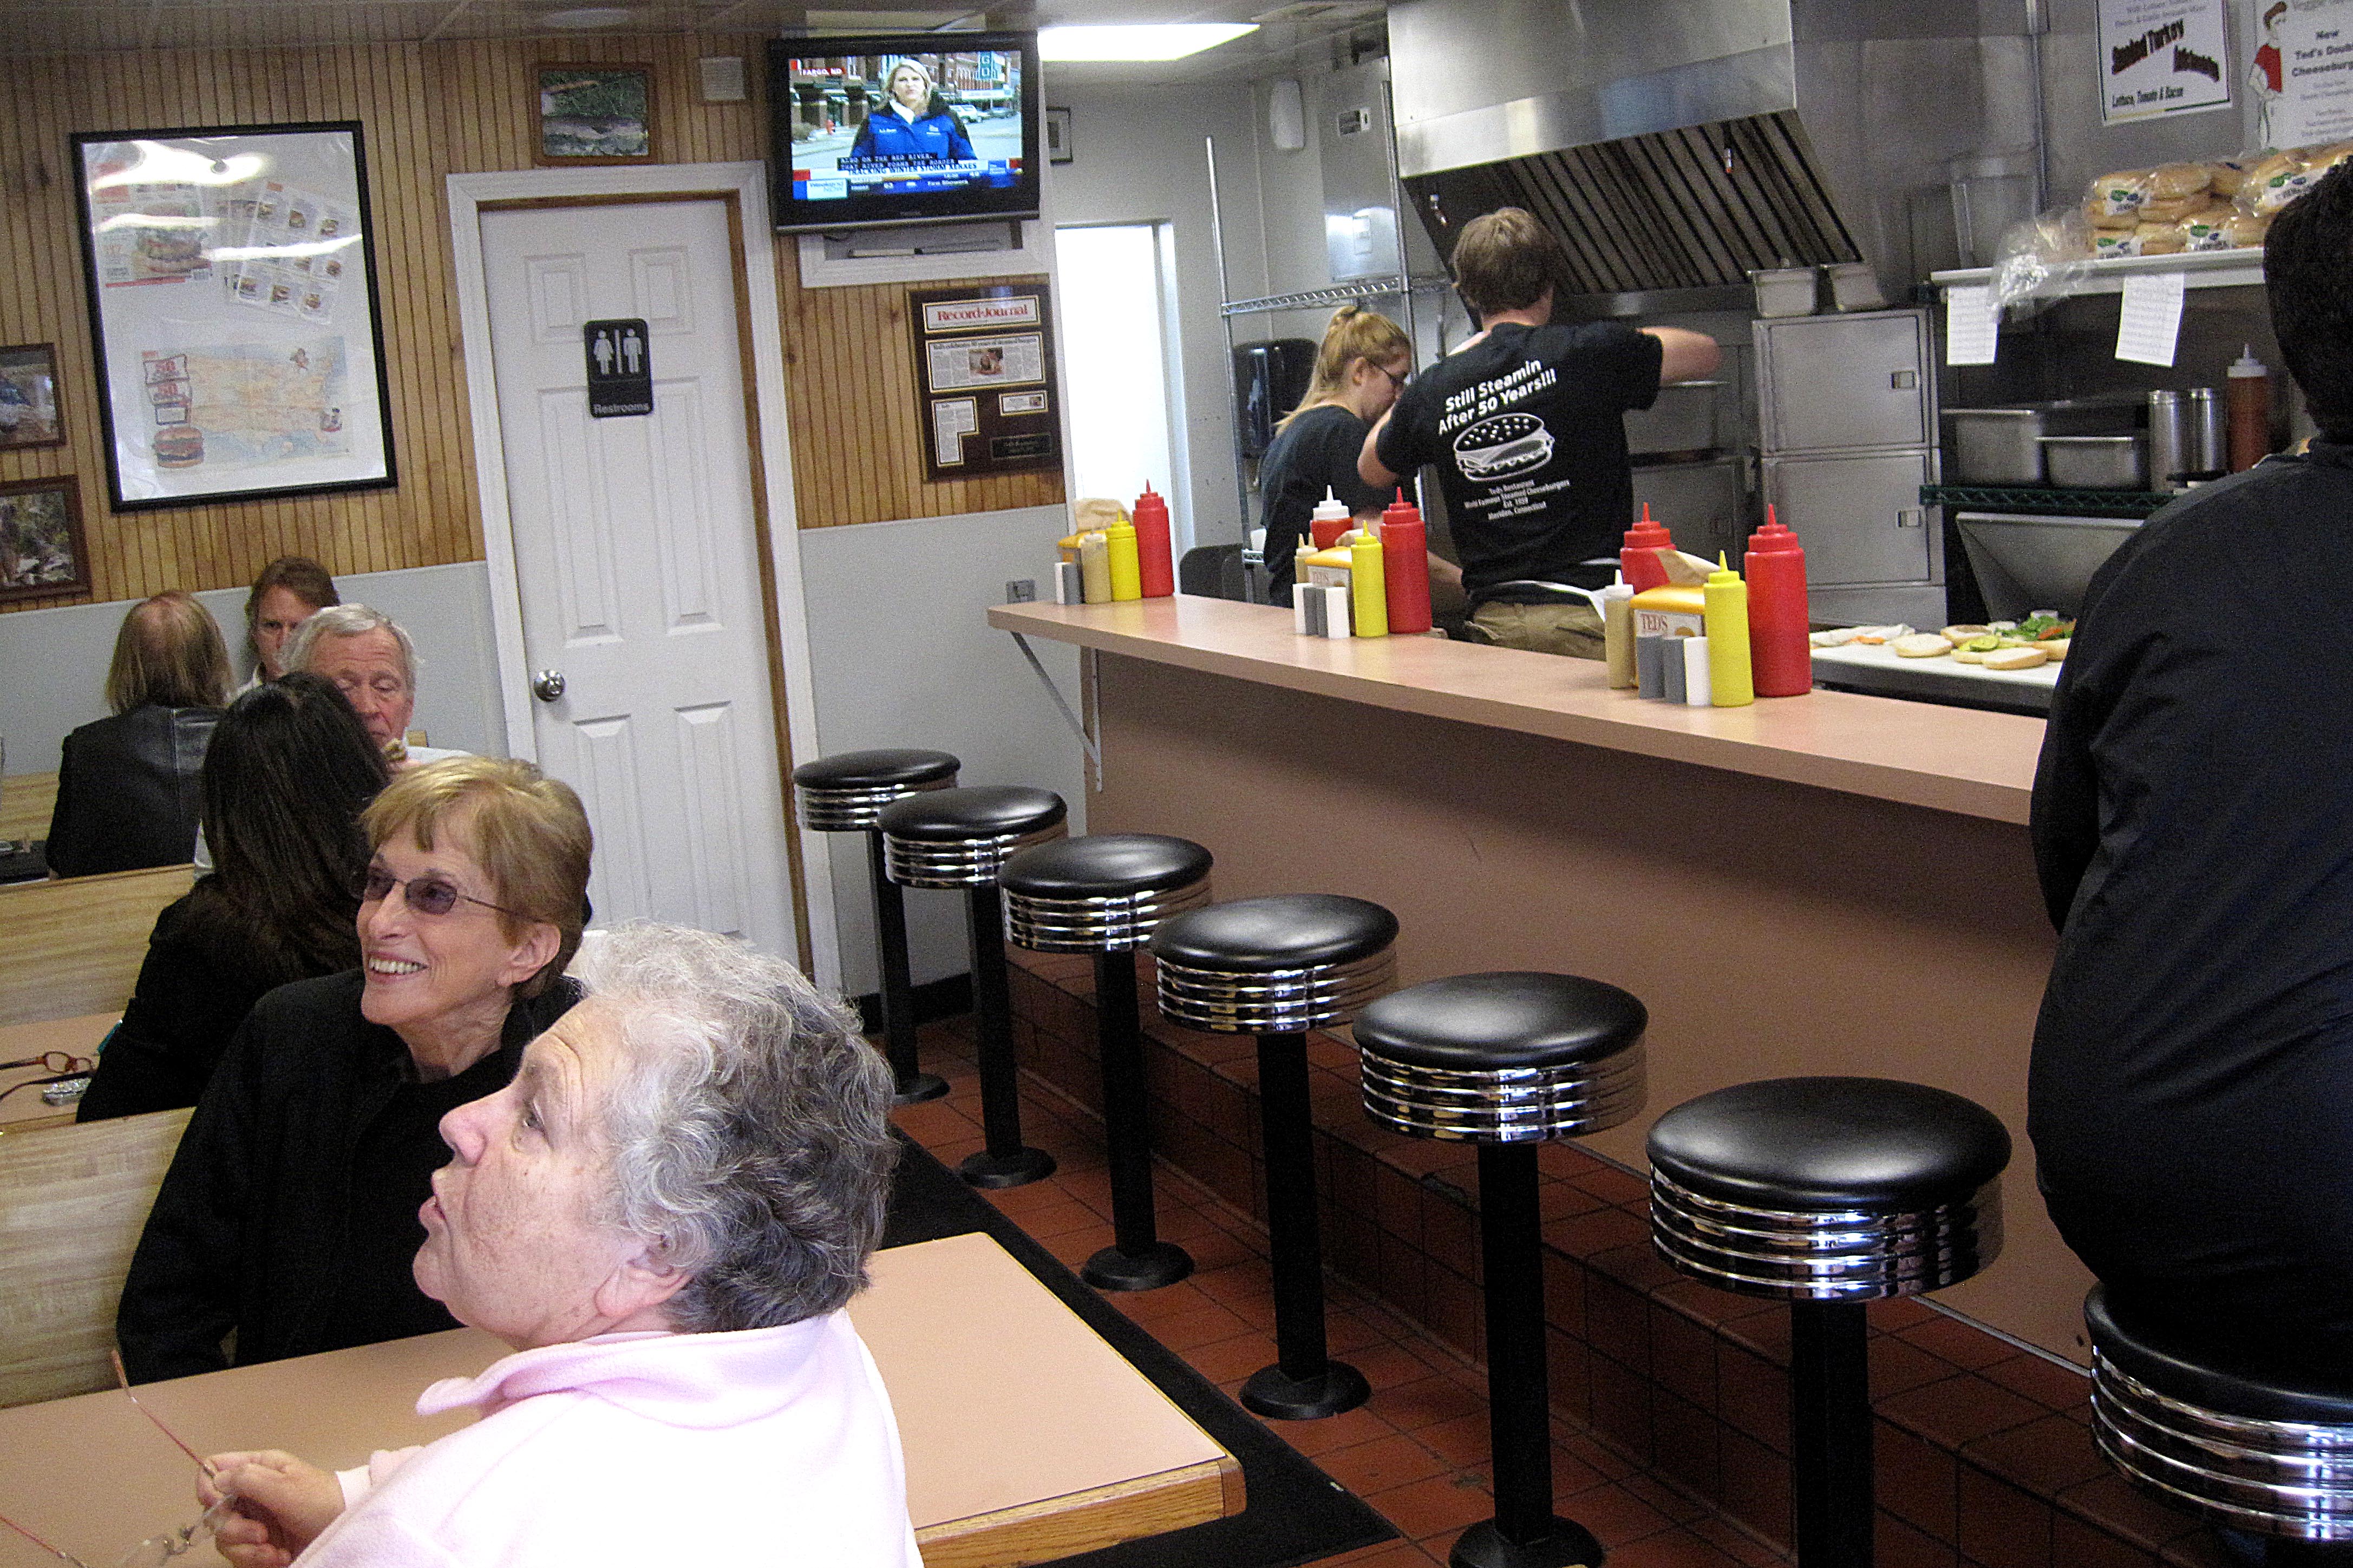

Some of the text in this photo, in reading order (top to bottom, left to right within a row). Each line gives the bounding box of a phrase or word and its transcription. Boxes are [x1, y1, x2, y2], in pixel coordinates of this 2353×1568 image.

[1446, 359, 1542, 412] Still Steamin
[1439, 408, 1475, 436] After
[1478, 396, 1498, 415] 50
